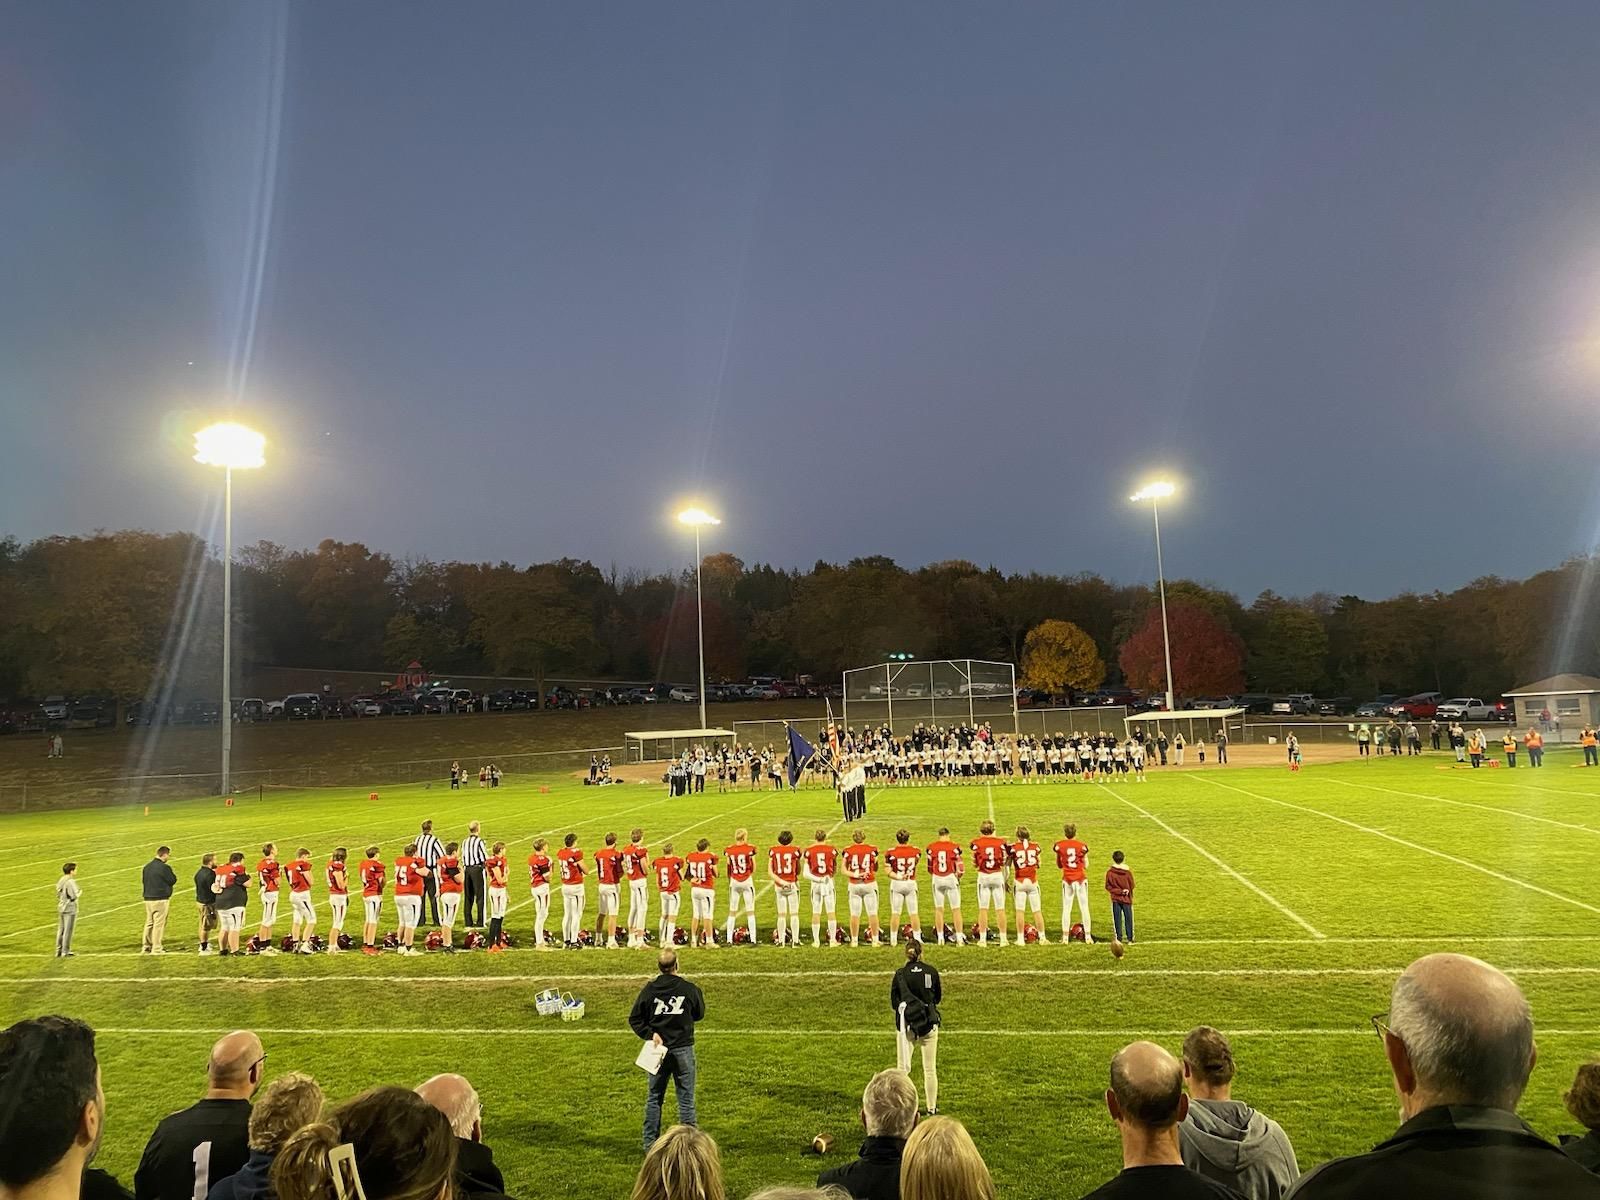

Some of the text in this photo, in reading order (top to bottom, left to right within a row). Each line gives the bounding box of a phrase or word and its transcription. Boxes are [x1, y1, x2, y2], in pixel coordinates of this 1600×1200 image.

[730, 854, 746, 874] 19
[775, 853, 792, 874] 13
[816, 853, 827, 874] 5
[851, 853, 870, 878] 44
[1066, 848, 1077, 868] 2
[192, 1141, 212, 1200] 1
